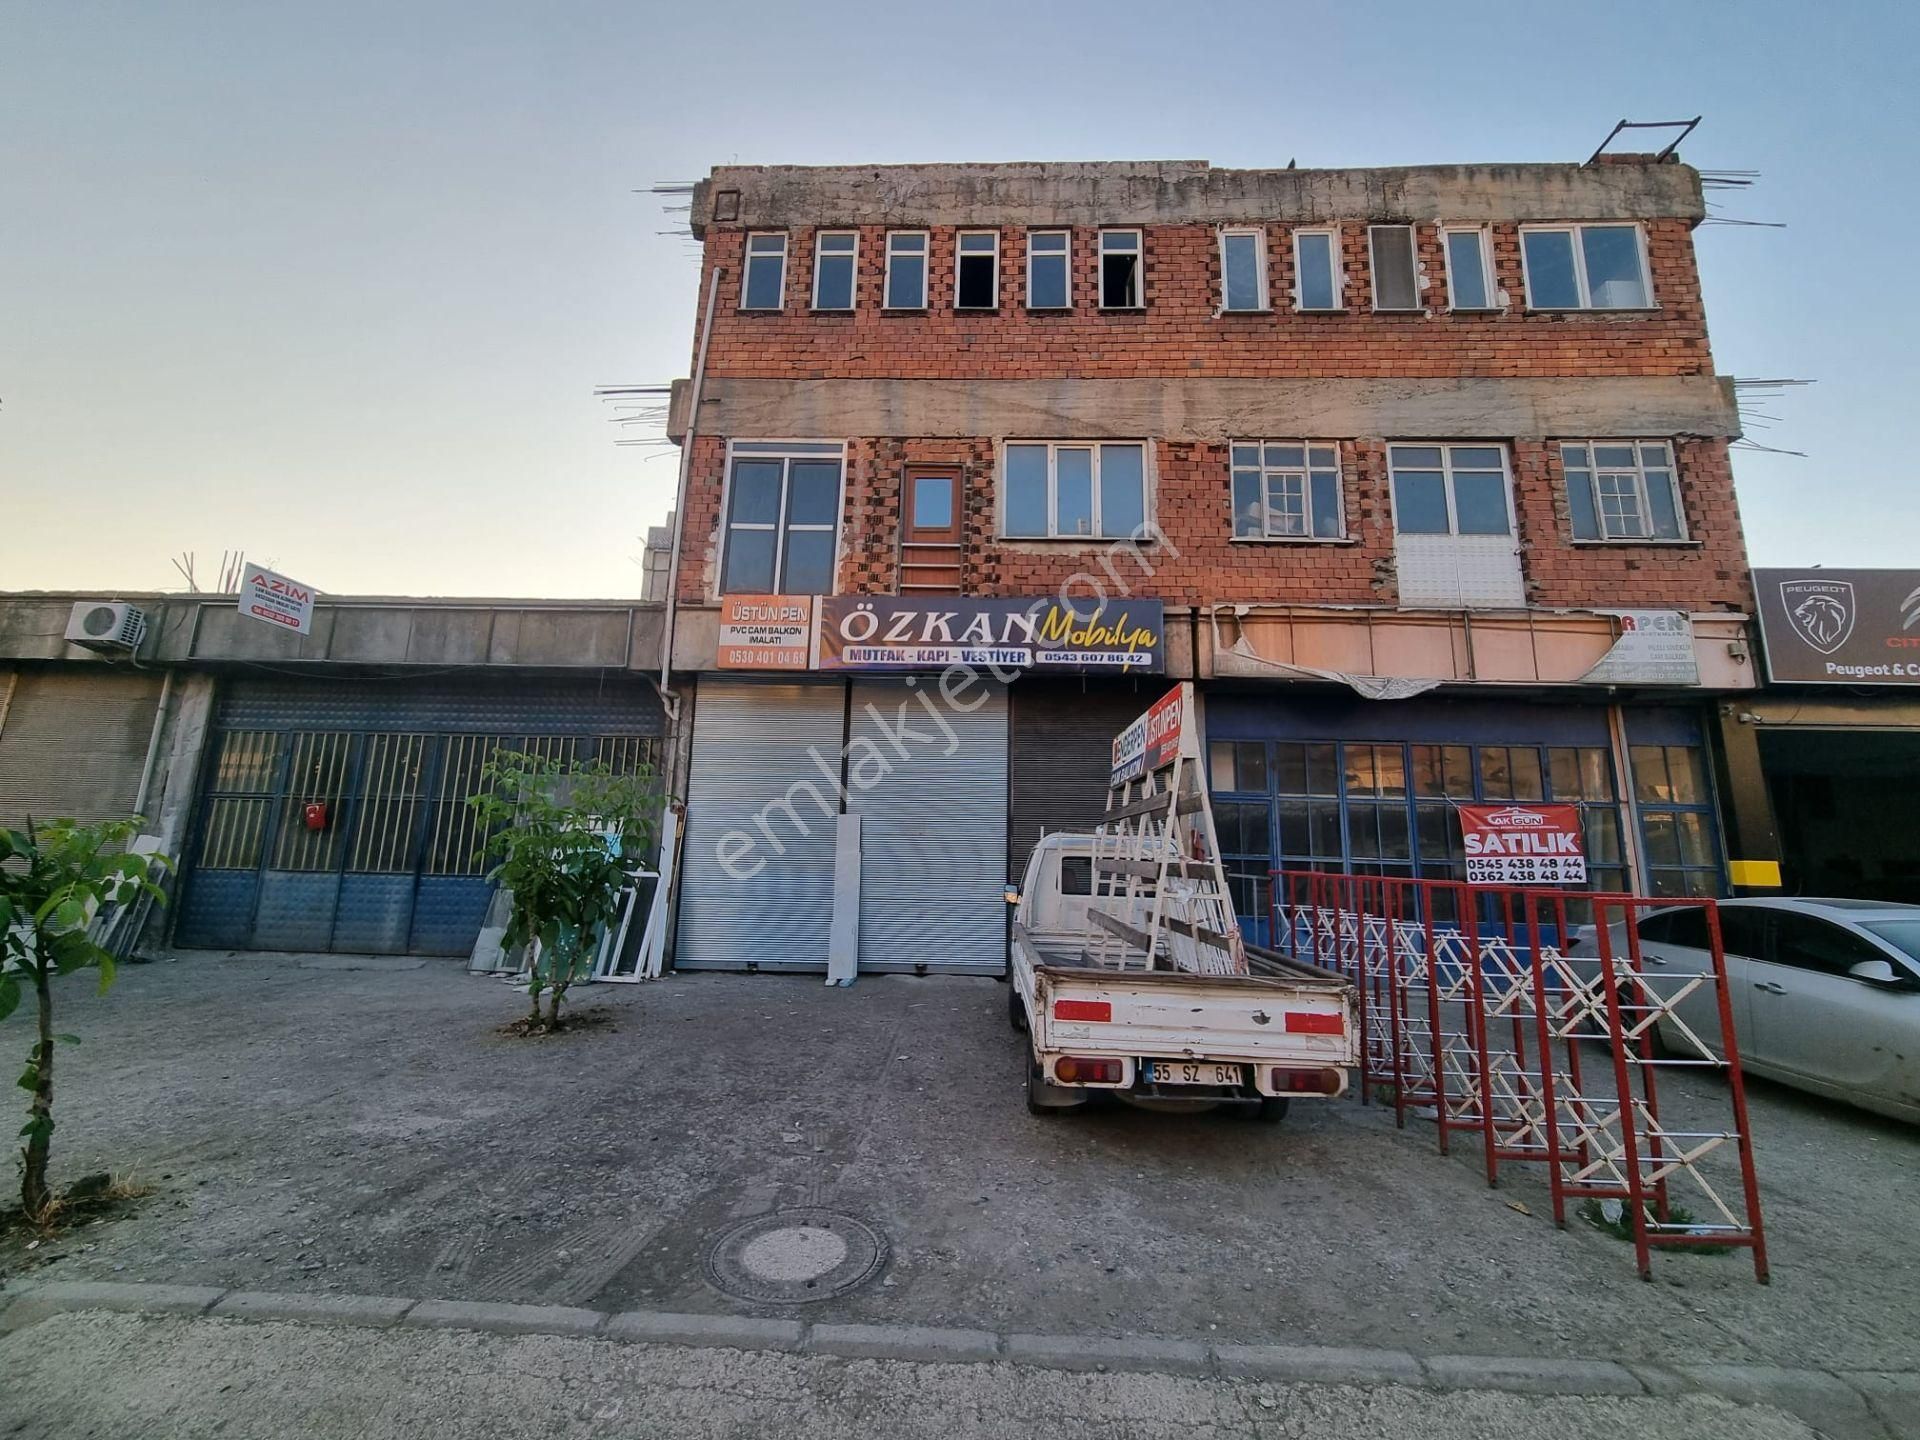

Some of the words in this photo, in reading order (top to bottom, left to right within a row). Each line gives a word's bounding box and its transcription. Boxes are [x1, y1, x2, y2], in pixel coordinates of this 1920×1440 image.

[1786, 585, 1847, 593] PEUGEOT
[732, 601, 778, 621] ÜSTÜN
[780, 606, 808, 622] PEN
[730, 626, 747, 634] PVC
[748, 627, 767, 635] CAM
[768, 627, 802, 635] BALKON
[839, 602, 1041, 644] ÖZKAN
[1037, 605, 1158, 673] Mobilya
[849, 648, 905, 661] MUTFAK
[917, 649, 950, 662] KAPI
[961, 648, 1026, 663] VESTİYER
[1044, 653, 1078, 662] 0543
[1081, 653, 1105, 662] 607
[1107, 653, 1124, 662] 86
[1126, 654, 1143, 663] 42
[1825, 662, 1891, 678] Peugeot
[1892, 663, 1905, 676] &
[1464, 832, 1580, 854] SATILIK
[1468, 859, 1503, 869] 0545
[1508, 858, 1535, 869] 438
[1539, 858, 1558, 868] 48
[1563, 858, 1581, 868] 44
[1469, 871, 1505, 882] 0362
[1509, 871, 1536, 881] 438
[1541, 870, 1559, 881] 48
[1564, 870, 1583, 881] 44
[1153, 1064, 1171, 1081] 55
[1182, 1065, 1201, 1082] SZ
[1215, 1065, 1240, 1083] 641
